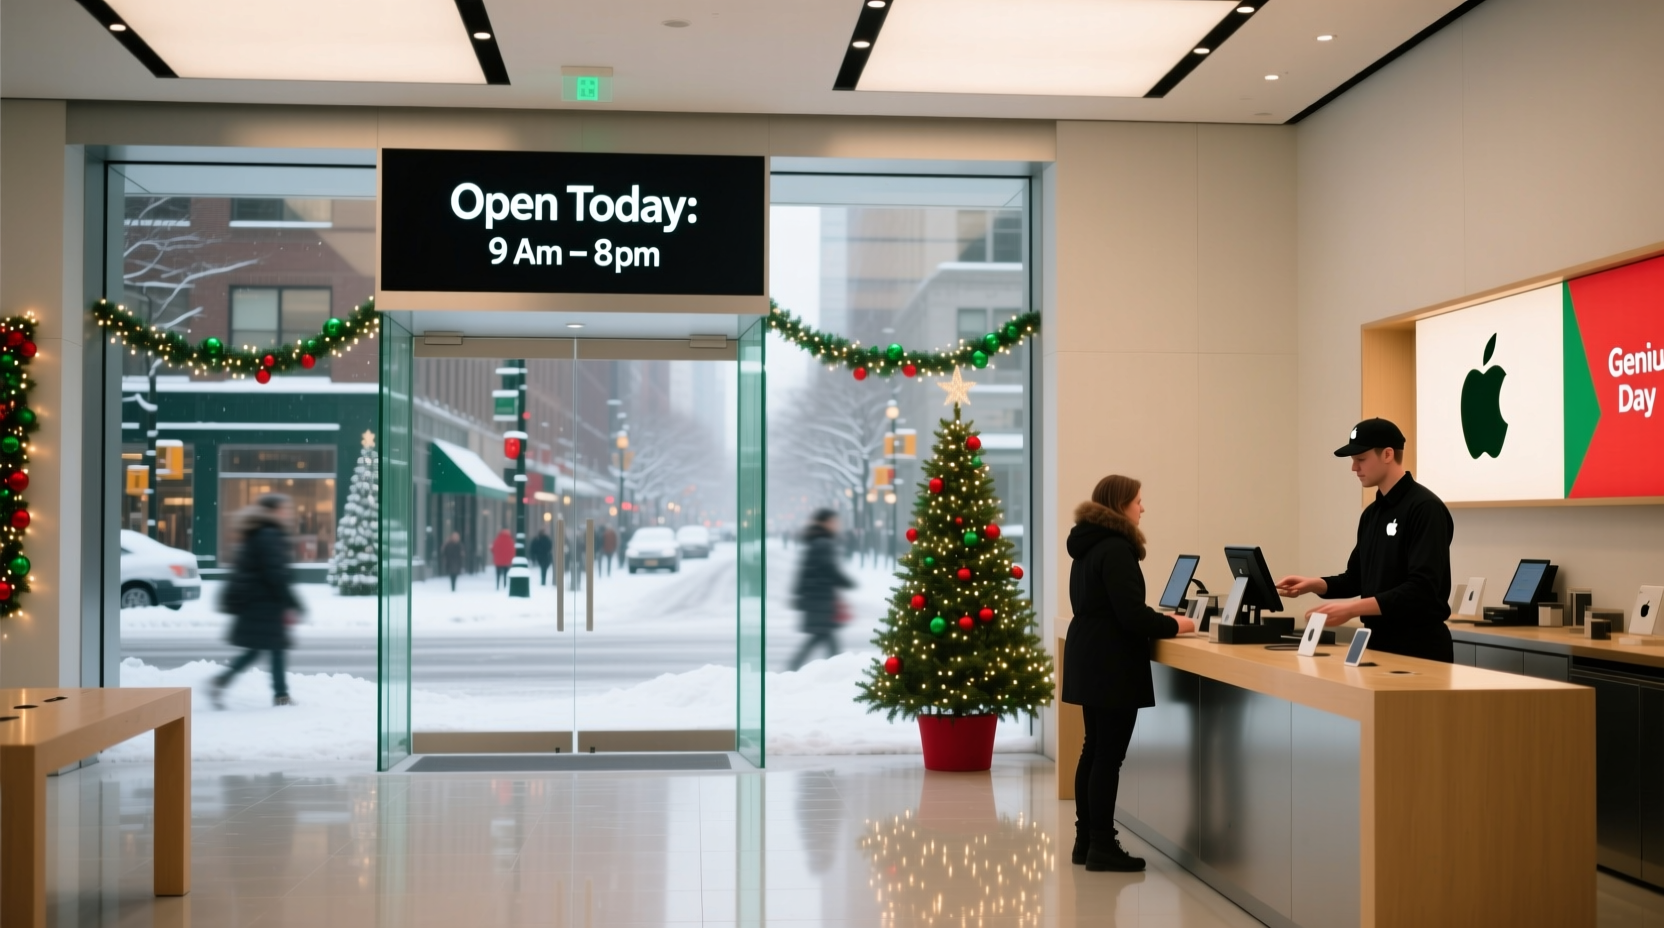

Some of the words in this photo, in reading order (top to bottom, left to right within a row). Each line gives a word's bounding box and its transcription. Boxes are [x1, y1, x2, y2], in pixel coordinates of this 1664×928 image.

[450, 182, 558, 229] Open
[566, 184, 698, 233] Today:
[488, 236, 508, 265] 9
[512, 237, 563, 266] Am
[593, 238, 660, 274] 8pm
[1608, 341, 1664, 378] Geniu
[1618, 383, 1657, 418] Day
